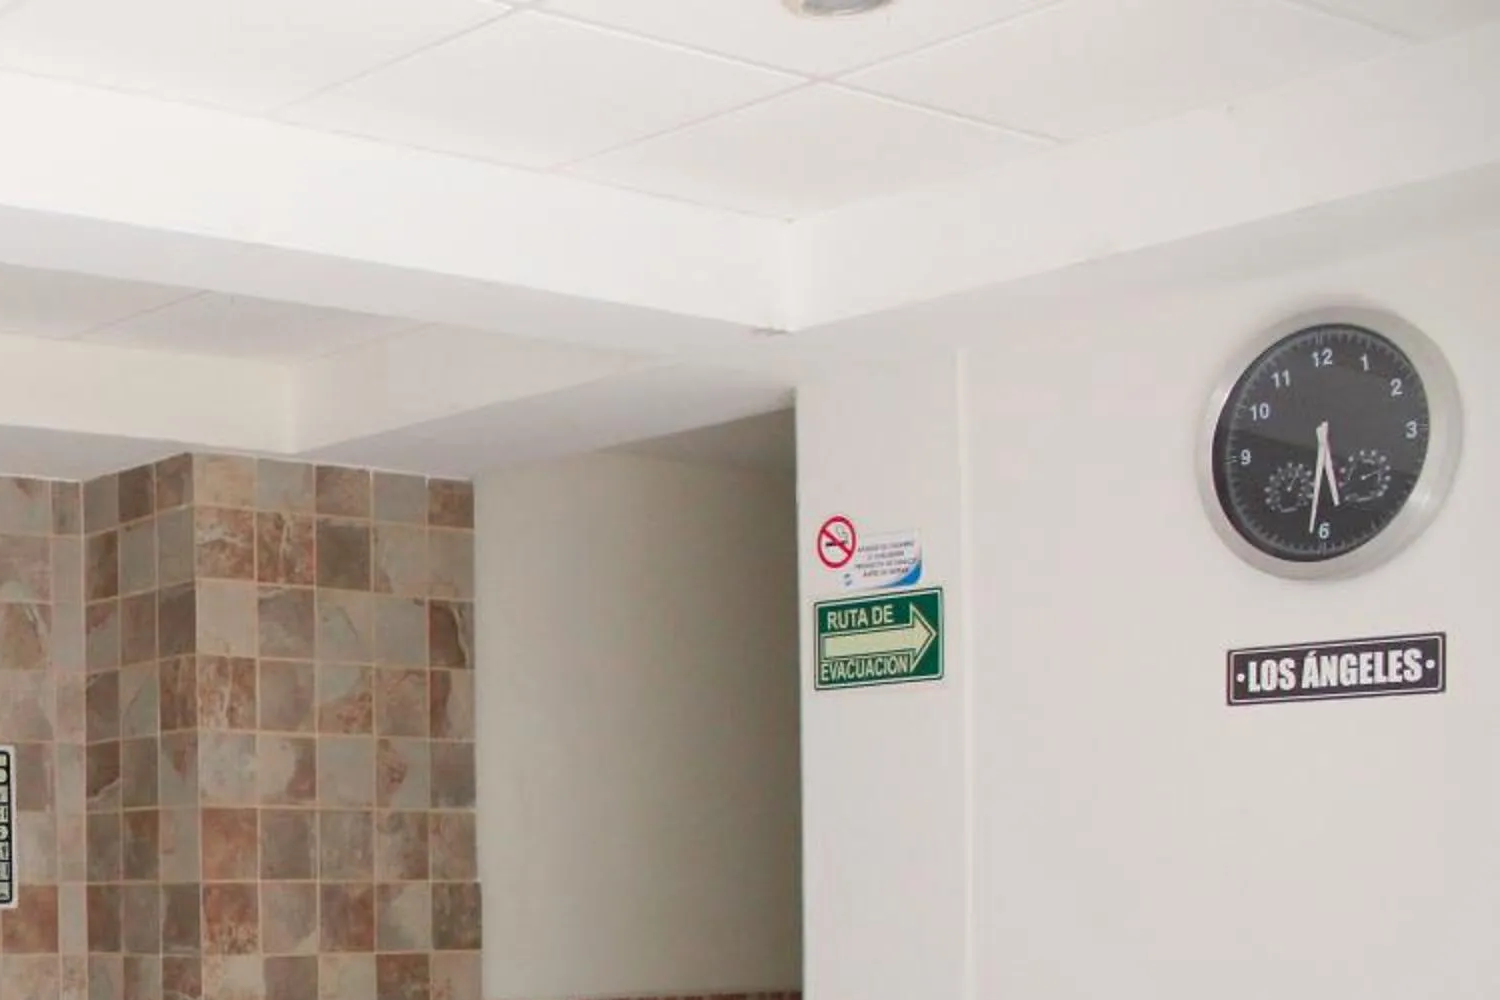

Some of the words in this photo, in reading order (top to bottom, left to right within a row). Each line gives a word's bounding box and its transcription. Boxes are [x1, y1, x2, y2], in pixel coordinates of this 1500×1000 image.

[1312, 348, 1333, 368] 12
[1360, 354, 1371, 371] 1
[1271, 369, 1291, 388] 11
[1390, 378, 1403, 397] 2
[1250, 402, 1270, 421] 10
[1405, 420, 1418, 439] 3
[1240, 449, 1251, 466] 9
[1318, 522, 1330, 539] 6
[827, 608, 869, 630] RUTA
[871, 604, 894, 625] DE
[1247, 657, 1296, 692] LOS
[1301, 648, 1423, 688] ÁNGELES
